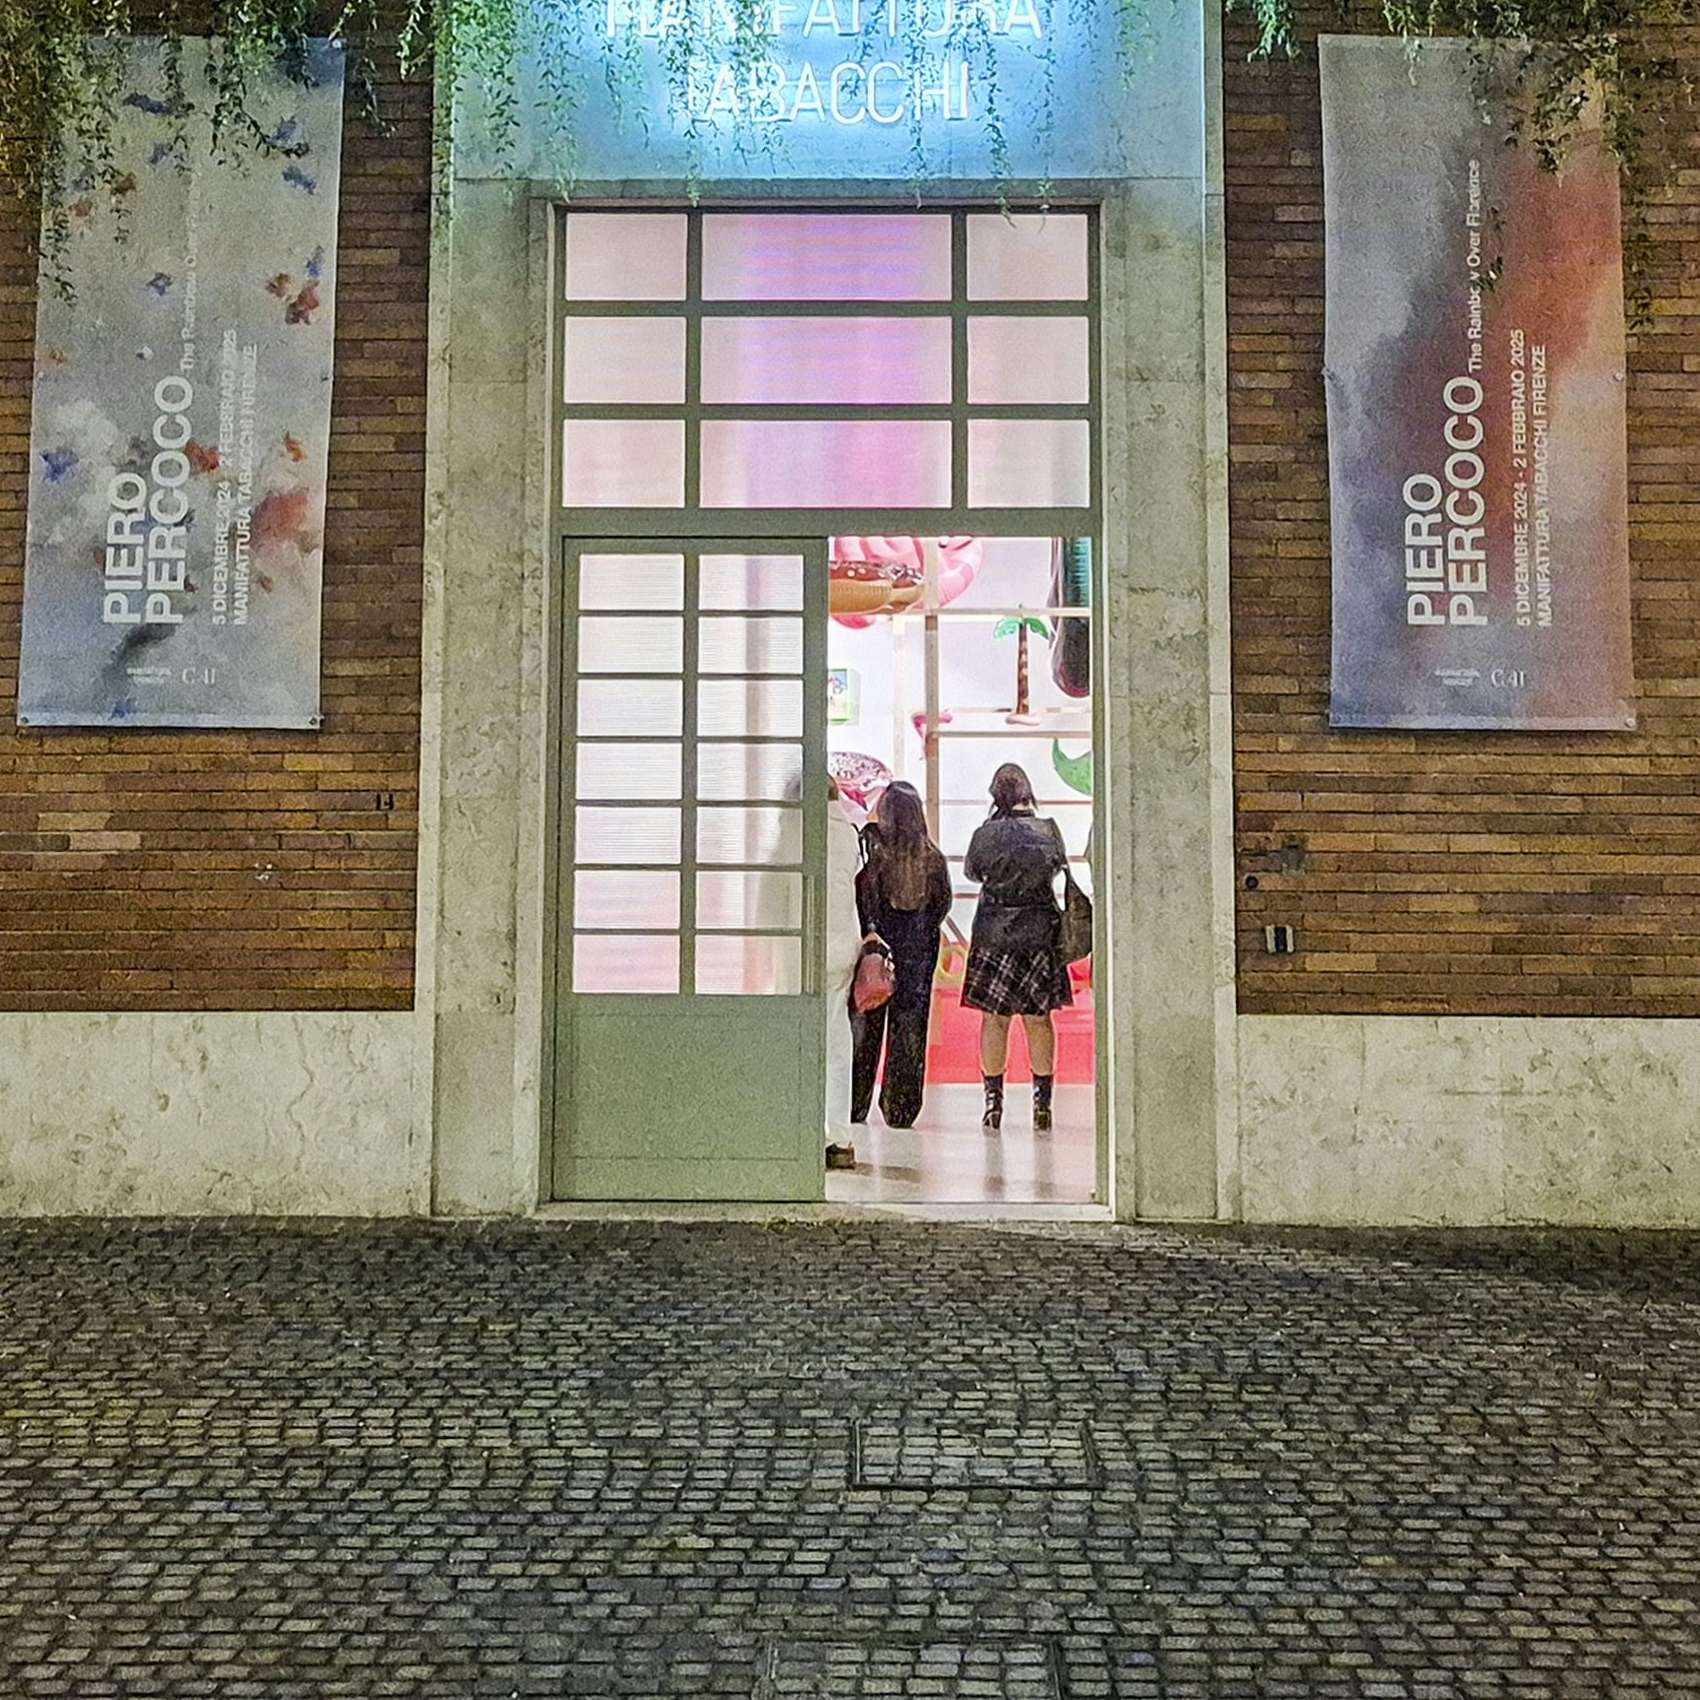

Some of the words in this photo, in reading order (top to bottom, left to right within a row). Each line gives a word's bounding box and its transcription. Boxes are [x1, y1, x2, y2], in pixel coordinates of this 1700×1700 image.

[688, 61, 970, 124] TABACCHI
[1466, 159, 1481, 226] Florence
[1466, 231, 1481, 267] Over
[1468, 342, 1482, 373] The
[1510, 329, 1525, 367] 2025
[1531, 345, 1547, 415] FIRENZE
[1511, 370, 1527, 454] FEBBRAIO
[145, 375, 194, 624] PERCOCO
[1513, 457, 1527, 469] 2
[1513, 481, 1528, 520] 2024
[1533, 420, 1550, 504] TABACCHI
[1443, 376, 1489, 626] PERCOCO
[103, 472, 147, 624] PIERO
[213, 521, 230, 611] DICEMBRE
[234, 506, 252, 625] MANIFATTURA
[1402, 473, 1446, 625] PIERO
[1514, 523, 1531, 613] DICEMBRE
[1534, 507, 1552, 628] MANIFATTURA
[212, 615, 227, 625] 5
[1516, 615, 1531, 626] 5
